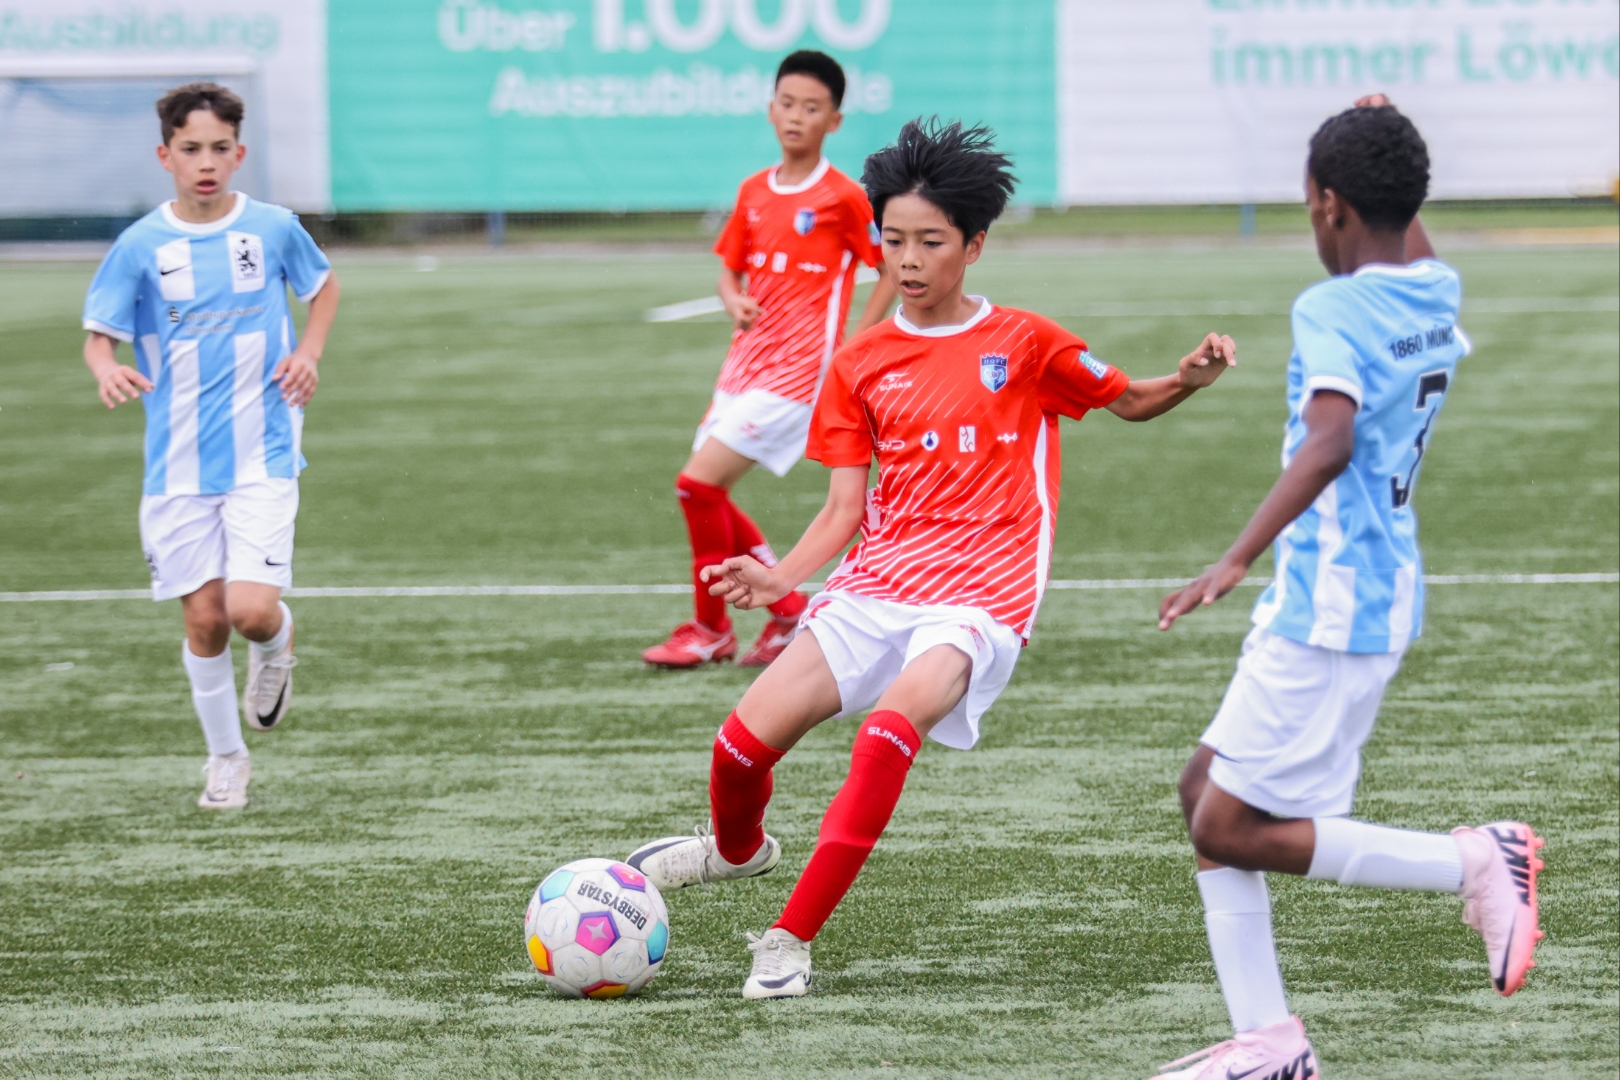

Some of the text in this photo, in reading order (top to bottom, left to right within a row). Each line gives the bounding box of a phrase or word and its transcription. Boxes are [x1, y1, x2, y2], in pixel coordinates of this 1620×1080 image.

[1212, 26, 1436, 84] immer
[1389, 333, 1424, 361] 1860
[880, 381, 912, 391] SUNAIS
[867, 726, 912, 757] SUNAIS
[577, 882, 648, 931] DERBYSTAR
